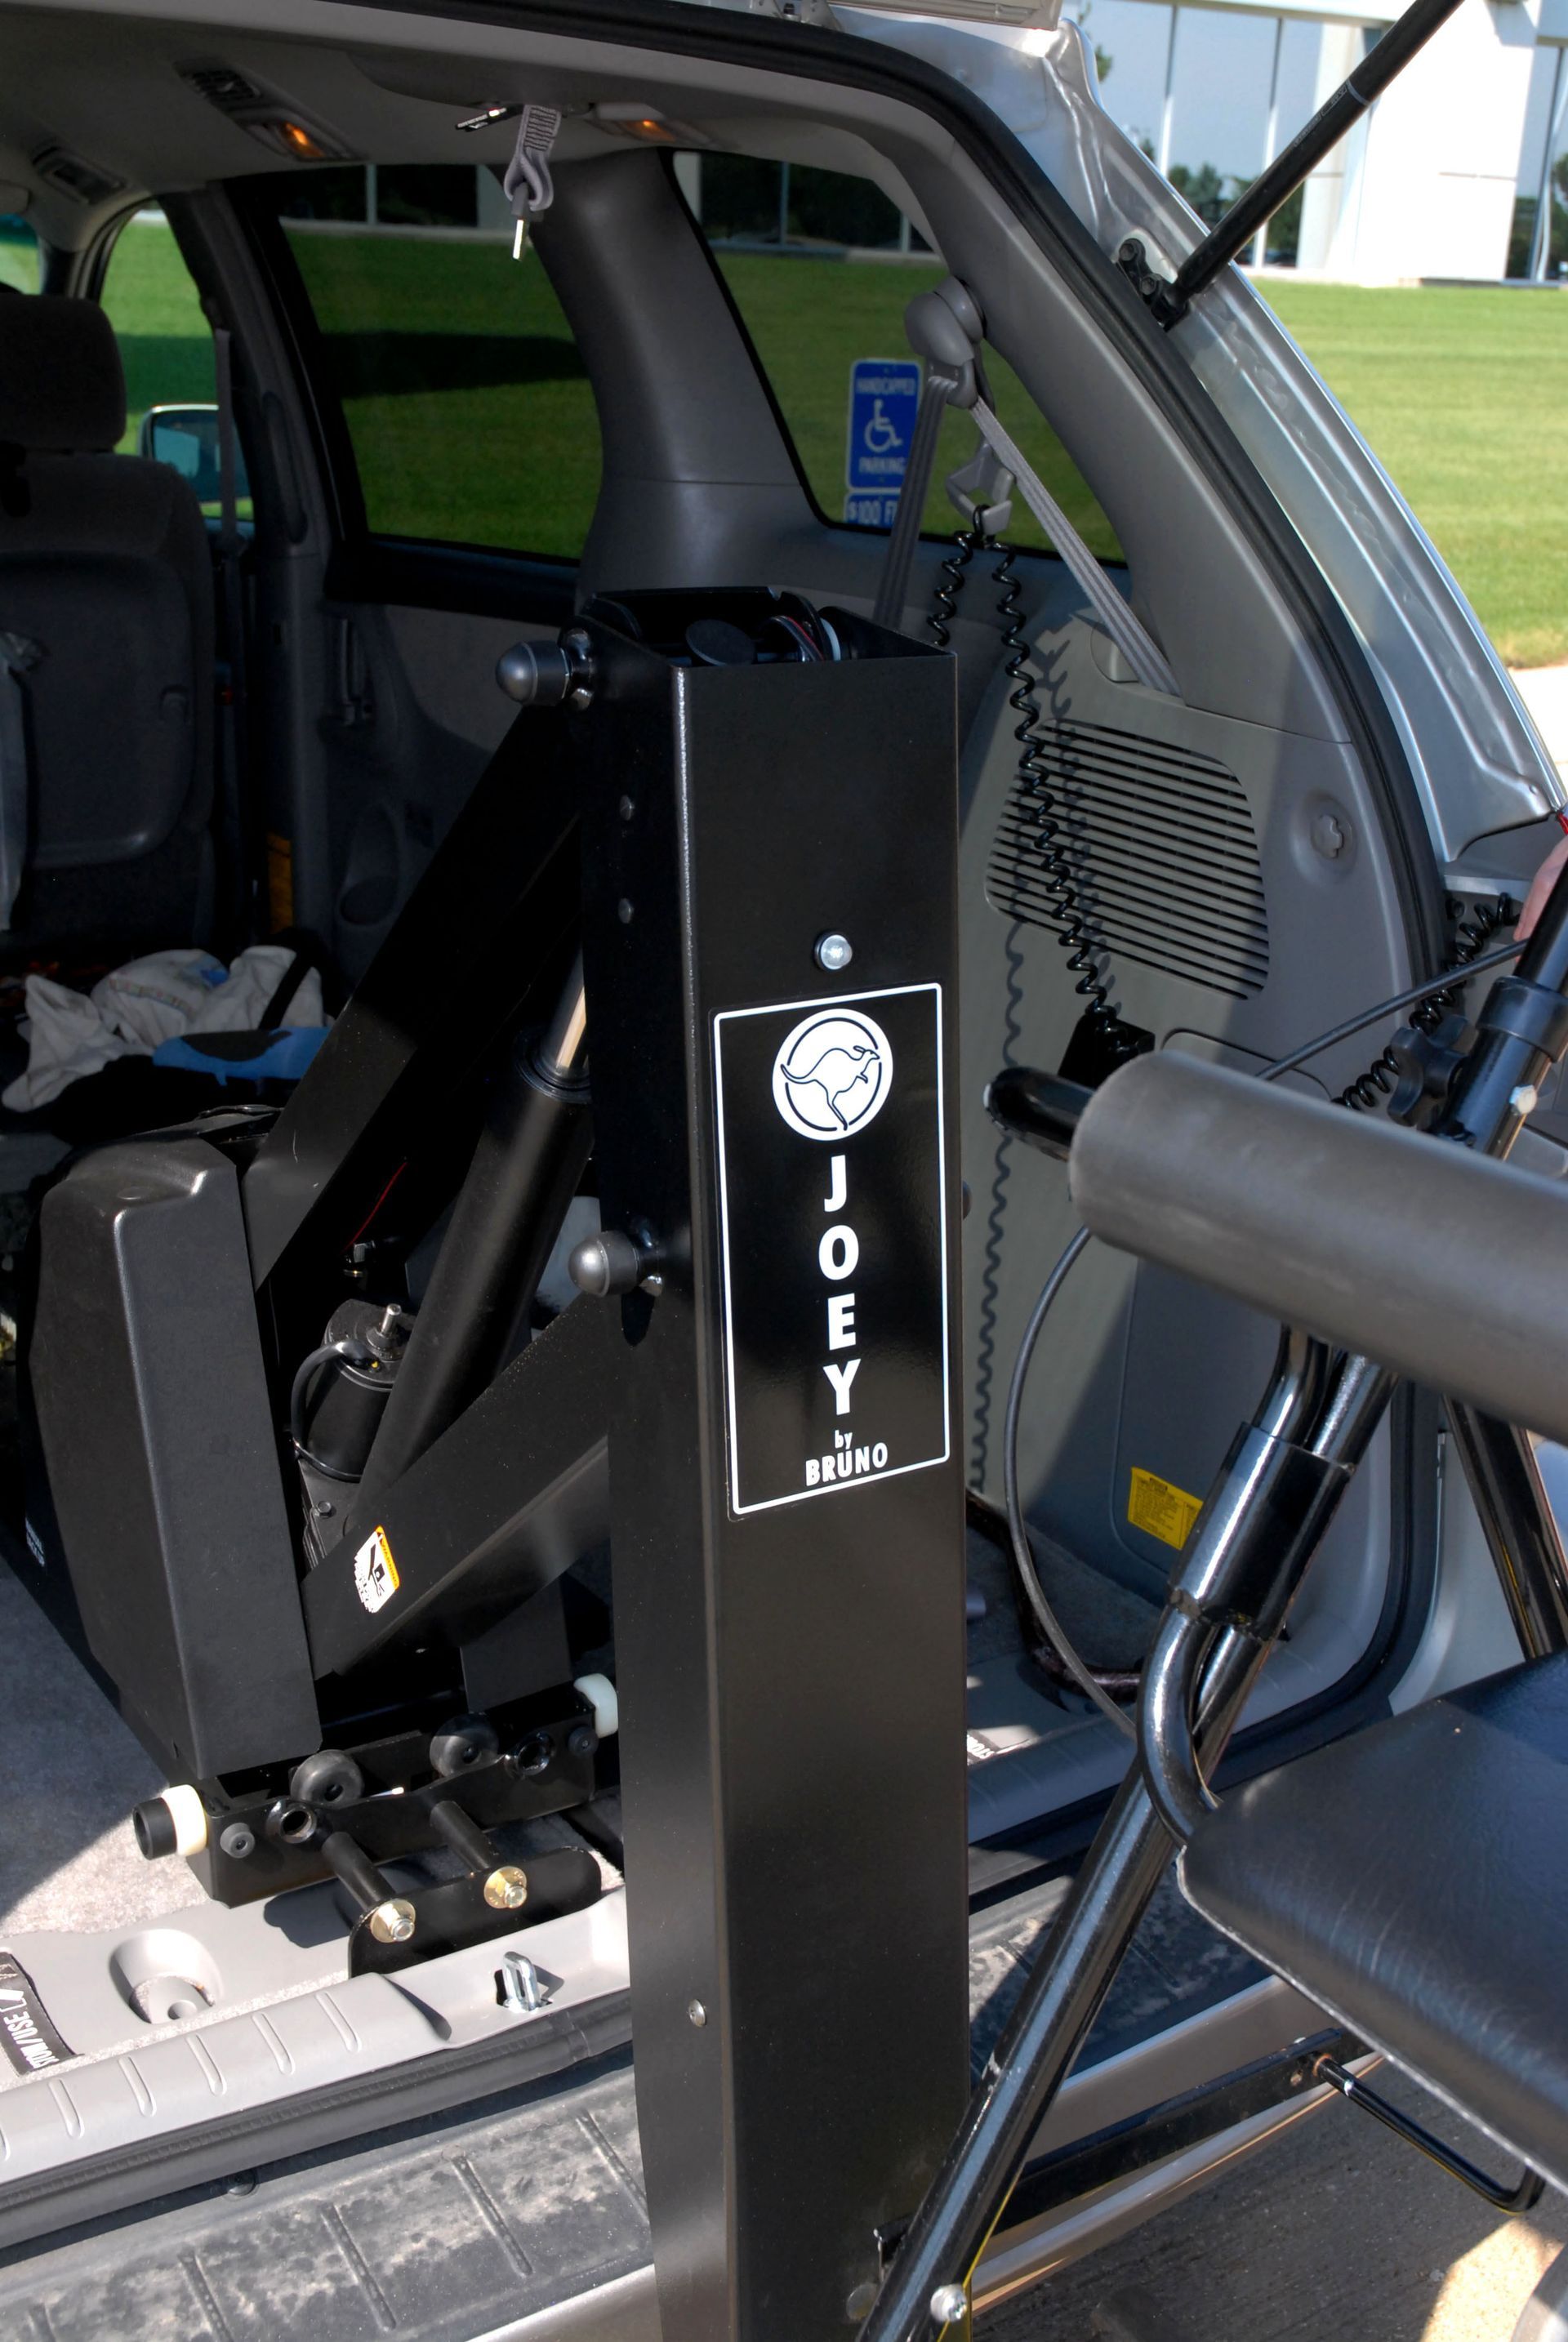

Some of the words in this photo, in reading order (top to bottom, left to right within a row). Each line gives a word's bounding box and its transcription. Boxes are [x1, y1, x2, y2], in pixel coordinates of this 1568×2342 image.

[858, 456, 906, 474] PARKING
[884, 500, 899, 525] FI
[819, 1155, 861, 1415] JOEY
[835, 1430, 853, 1449] by
[805, 1442, 888, 1486] BRUNO
[3, 2011, 60, 2068] STOW/USE
